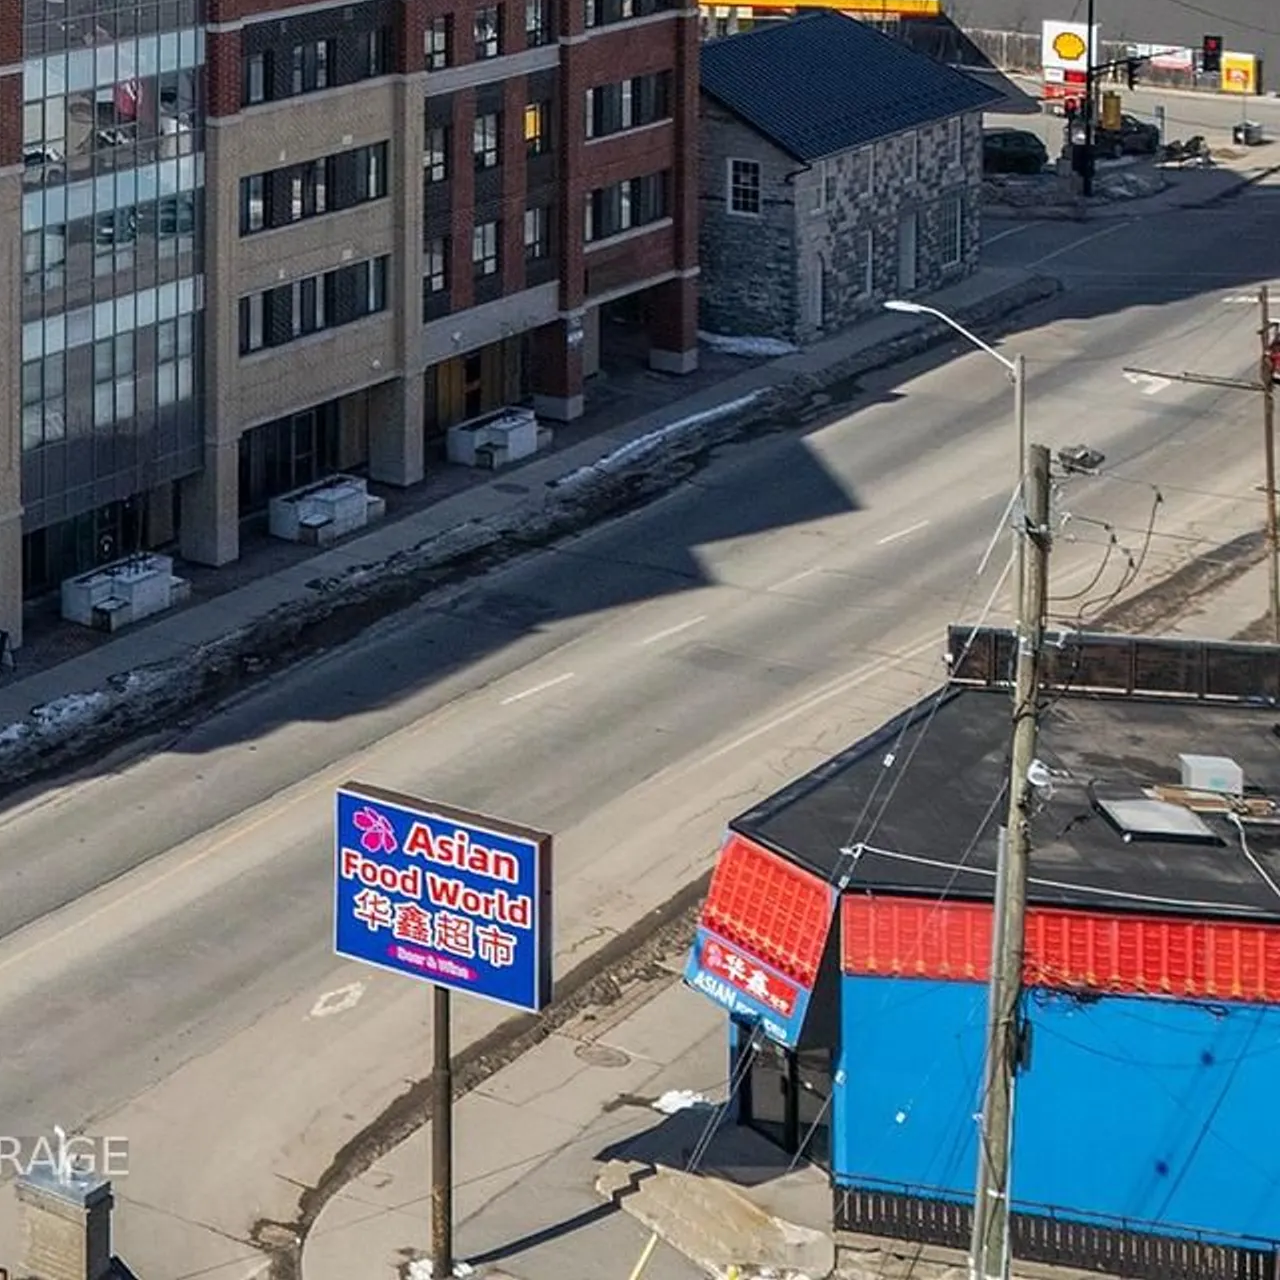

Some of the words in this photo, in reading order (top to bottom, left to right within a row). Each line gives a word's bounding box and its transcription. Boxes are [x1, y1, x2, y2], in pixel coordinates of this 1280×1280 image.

[403, 821, 519, 884] Asian
[341, 848, 422, 900] Food
[425, 870, 532, 930] World
[353, 887, 518, 969] 华鑫超市
[693, 970, 738, 1009] ASIAN
